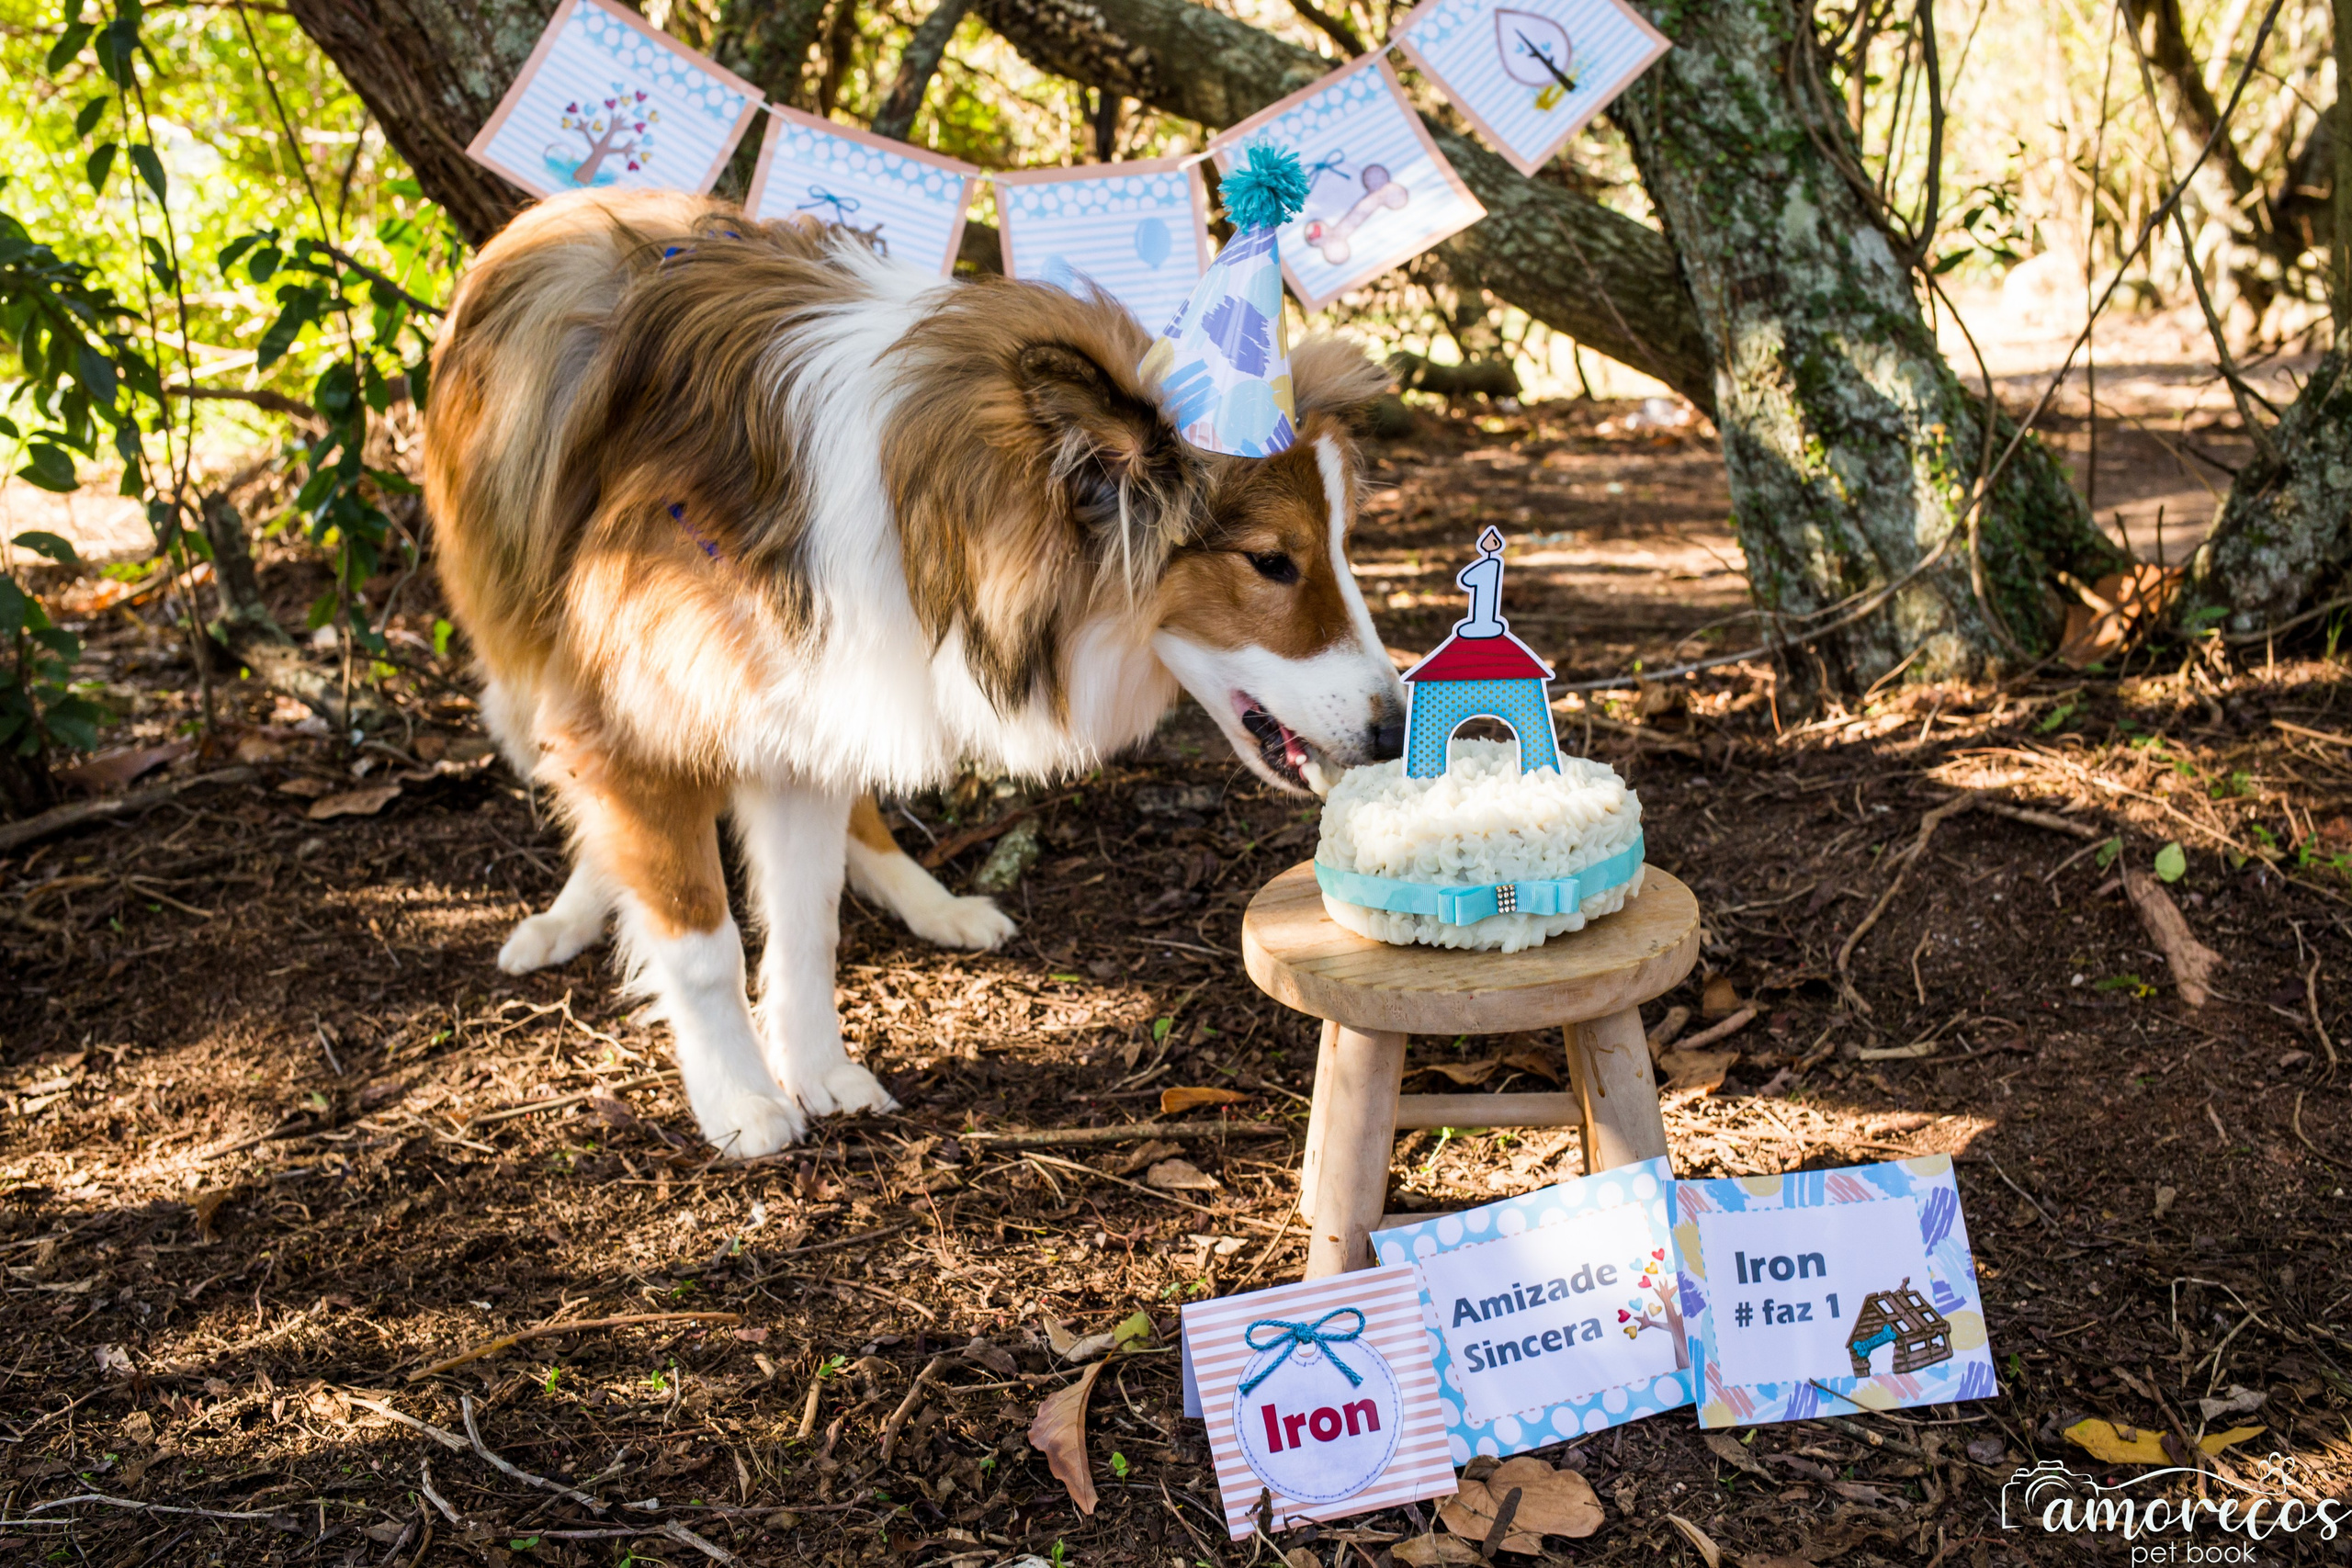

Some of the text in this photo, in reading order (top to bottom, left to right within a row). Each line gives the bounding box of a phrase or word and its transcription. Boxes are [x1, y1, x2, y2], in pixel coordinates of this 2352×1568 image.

[1456, 557, 1506, 639] 1
[1452, 1263, 1618, 1329] Amizade
[1735, 1250, 1826, 1285] Iron
[1761, 1298, 1814, 1325] faz
[1825, 1292, 1840, 1319] 1
[1464, 1316, 1604, 1373] Sincera
[1261, 1397, 1381, 1454] Iron
